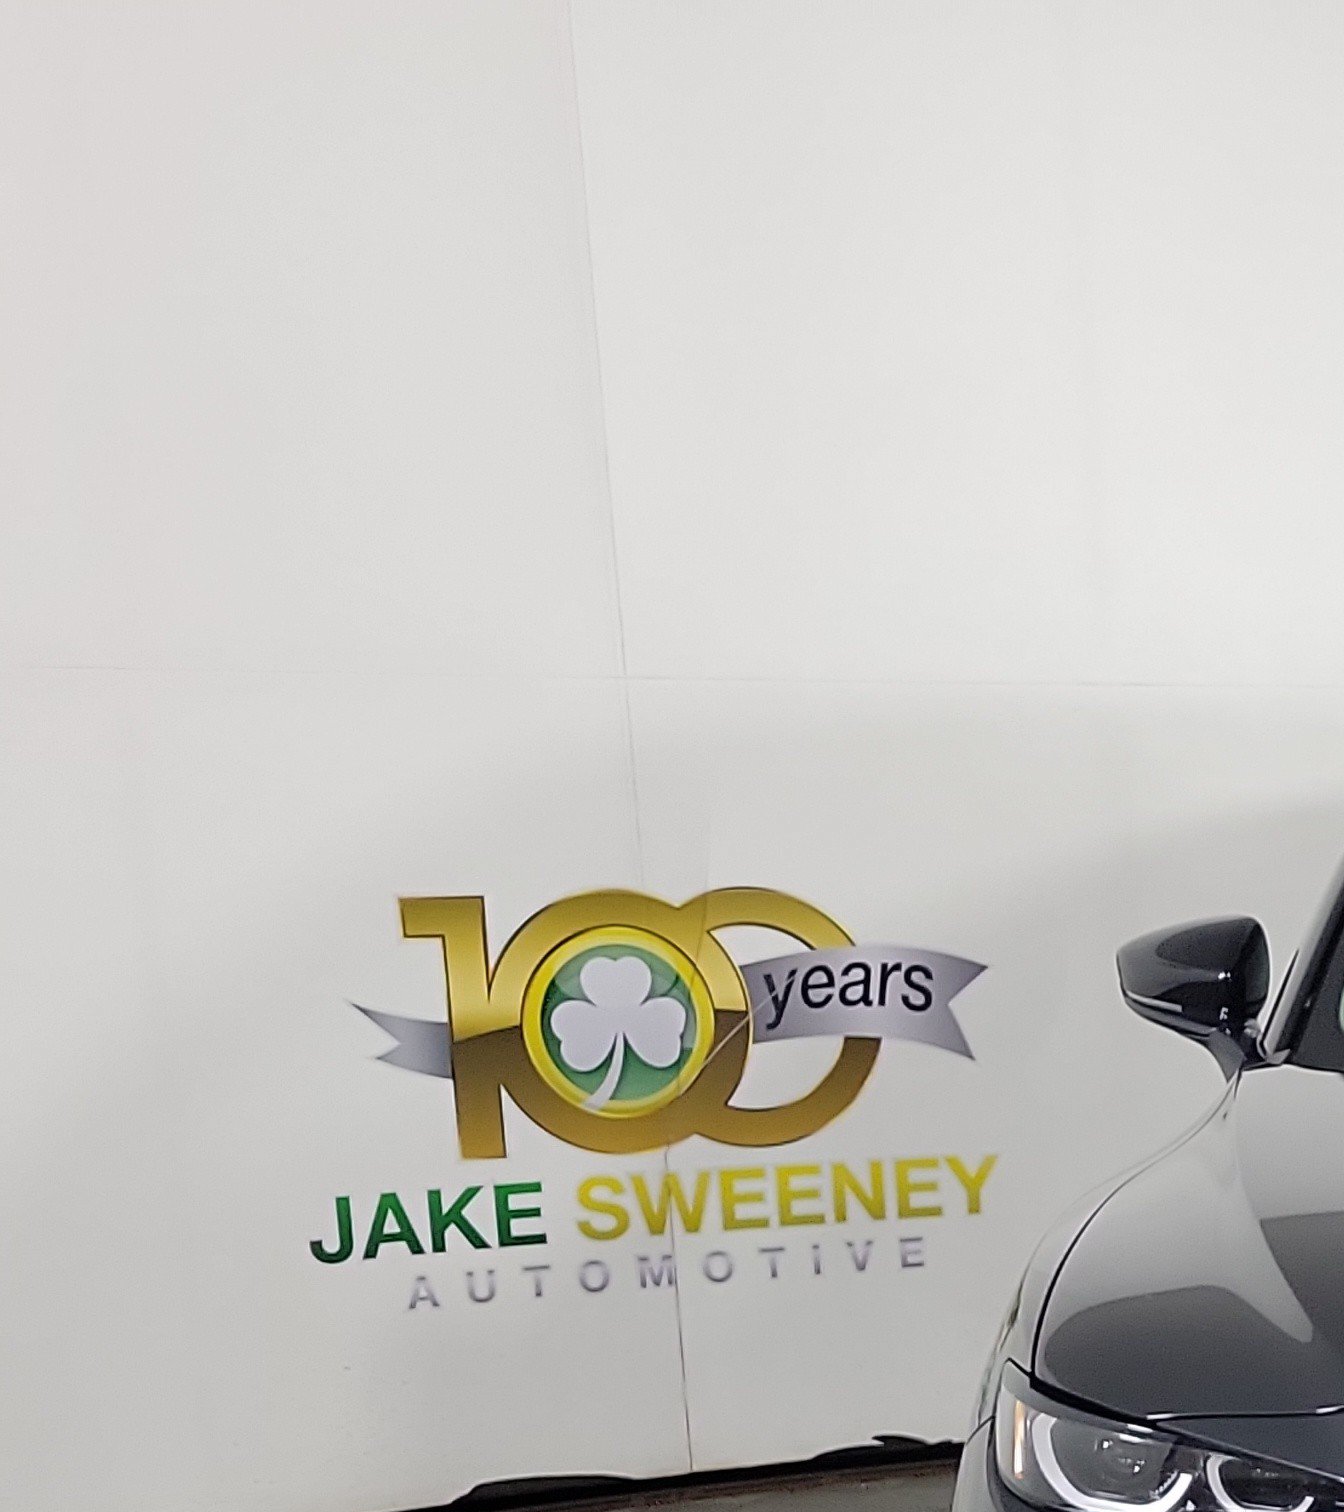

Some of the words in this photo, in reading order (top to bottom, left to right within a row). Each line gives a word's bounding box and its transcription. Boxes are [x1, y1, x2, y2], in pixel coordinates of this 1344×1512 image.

[399, 886, 882, 1158] 100
[763, 960, 934, 1030] years
[309, 1181, 548, 1265] JAKE
[575, 1155, 998, 1241] SWEENEY
[408, 1236, 926, 1310] AUTOMOTIVE
